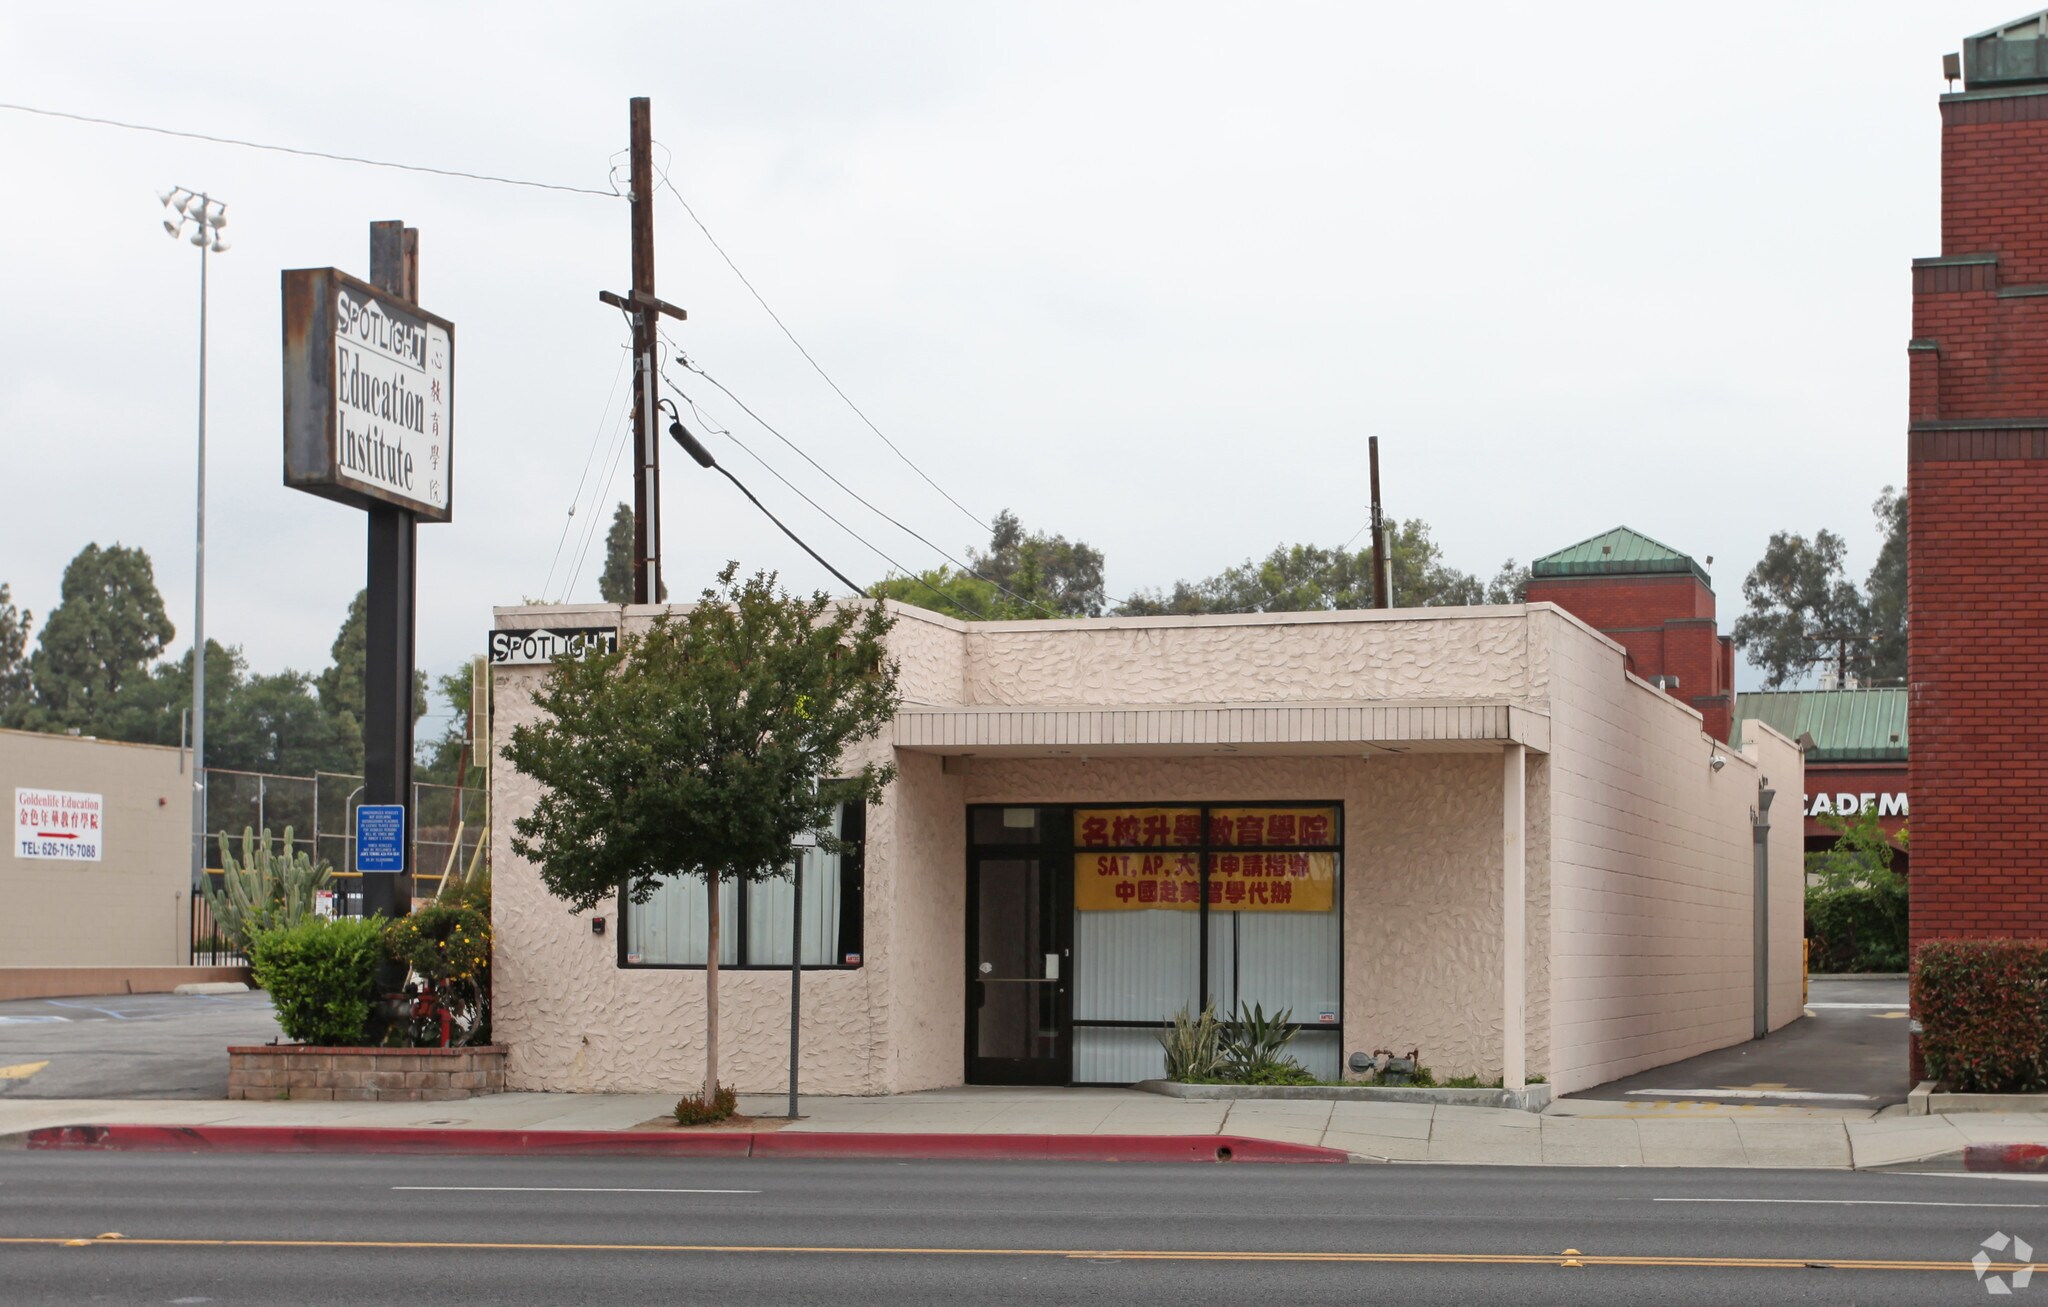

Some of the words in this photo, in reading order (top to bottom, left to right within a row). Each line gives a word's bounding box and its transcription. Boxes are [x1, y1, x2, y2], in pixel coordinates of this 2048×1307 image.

[337, 290, 425, 367] SPOTLIGHT
[338, 345, 425, 434] Education
[338, 409, 414, 491] Institute
[19, 792, 59, 807] Goldenlife
[61, 796, 99, 810] Education
[1803, 792, 1909, 816] ADEM
[22, 841, 40, 855] TEL:
[42, 842, 96, 858] 626-716-7088
[1097, 856, 1138, 878] SAT,
[1141, 856, 1171, 878] AP,
